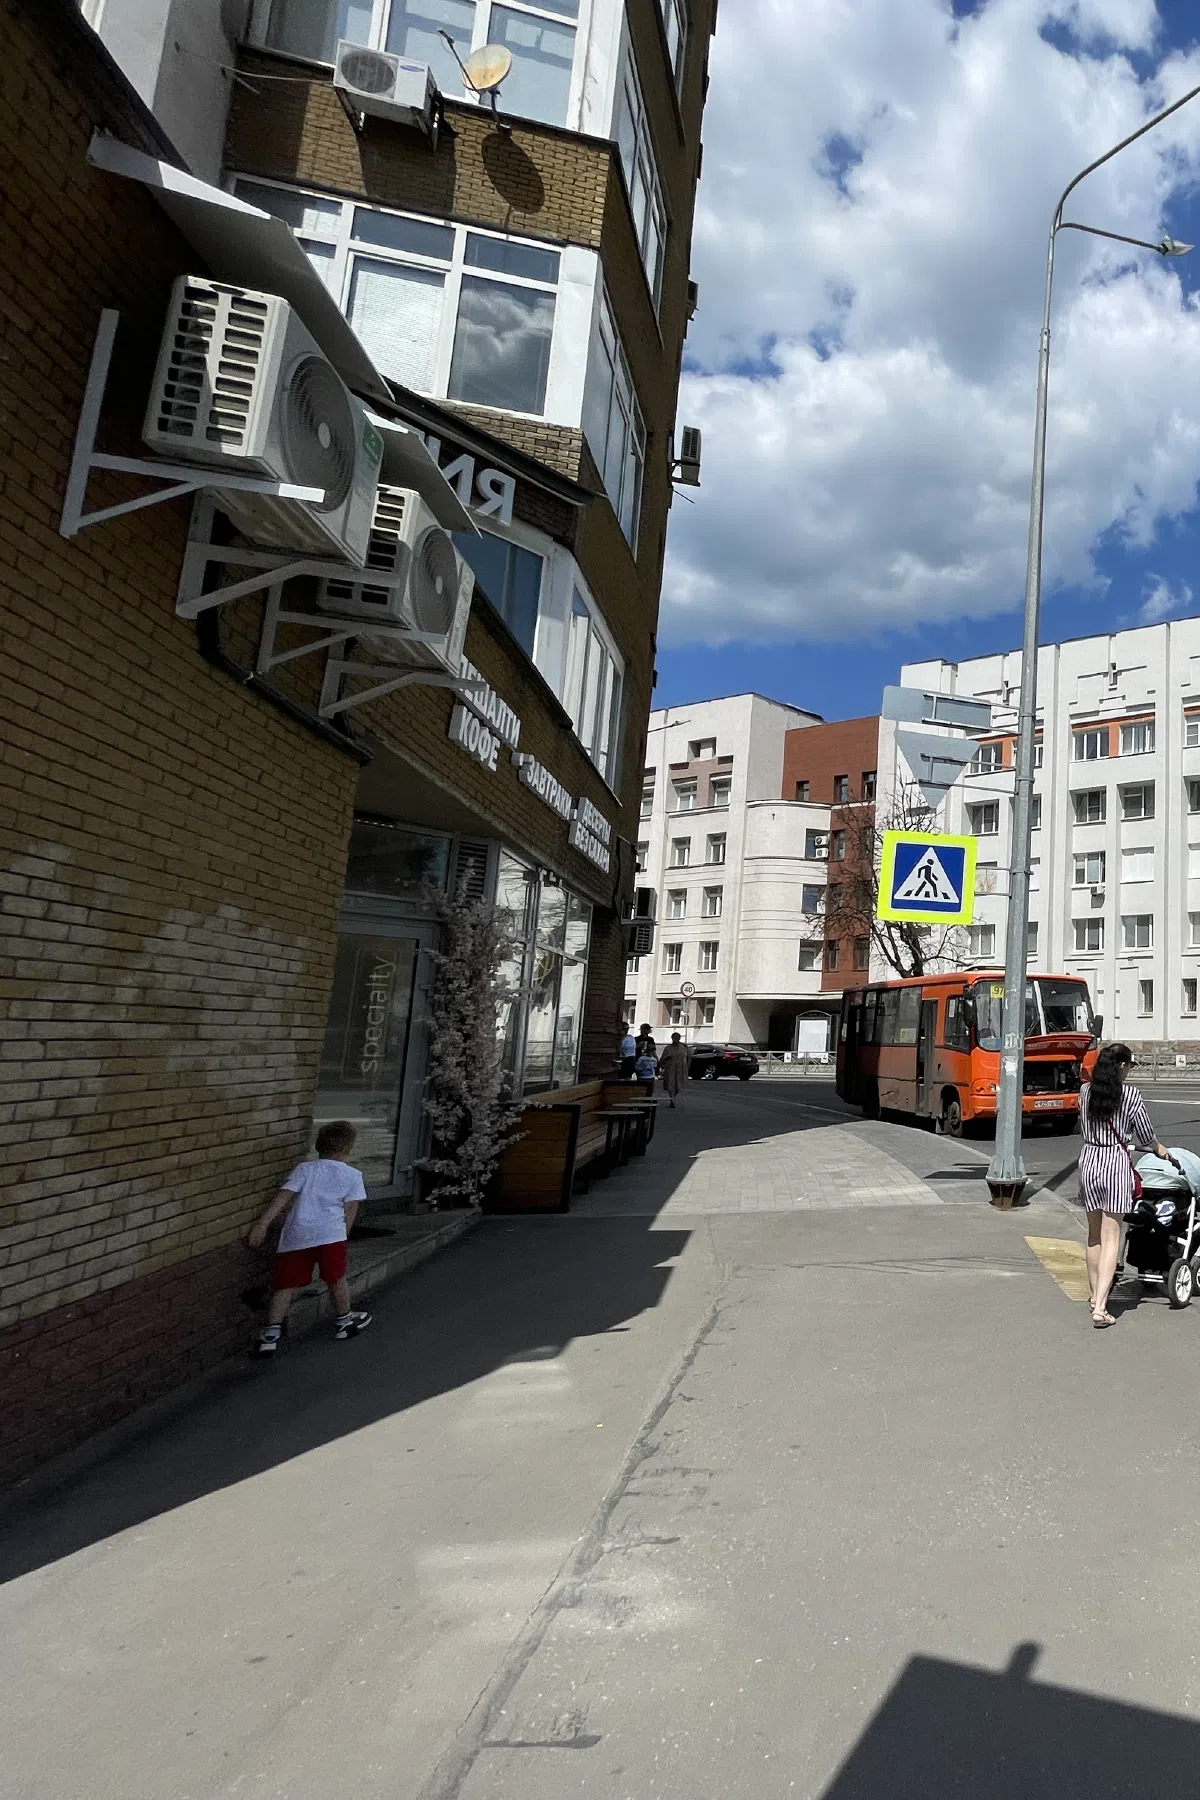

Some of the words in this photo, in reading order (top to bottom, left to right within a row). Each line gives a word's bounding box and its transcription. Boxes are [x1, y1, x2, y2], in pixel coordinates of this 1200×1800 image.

[459, 706, 500, 772] КОФЕ
[526, 754, 572, 820] ЗАВТРАКИ
[361, 955, 396, 1073] specialty
